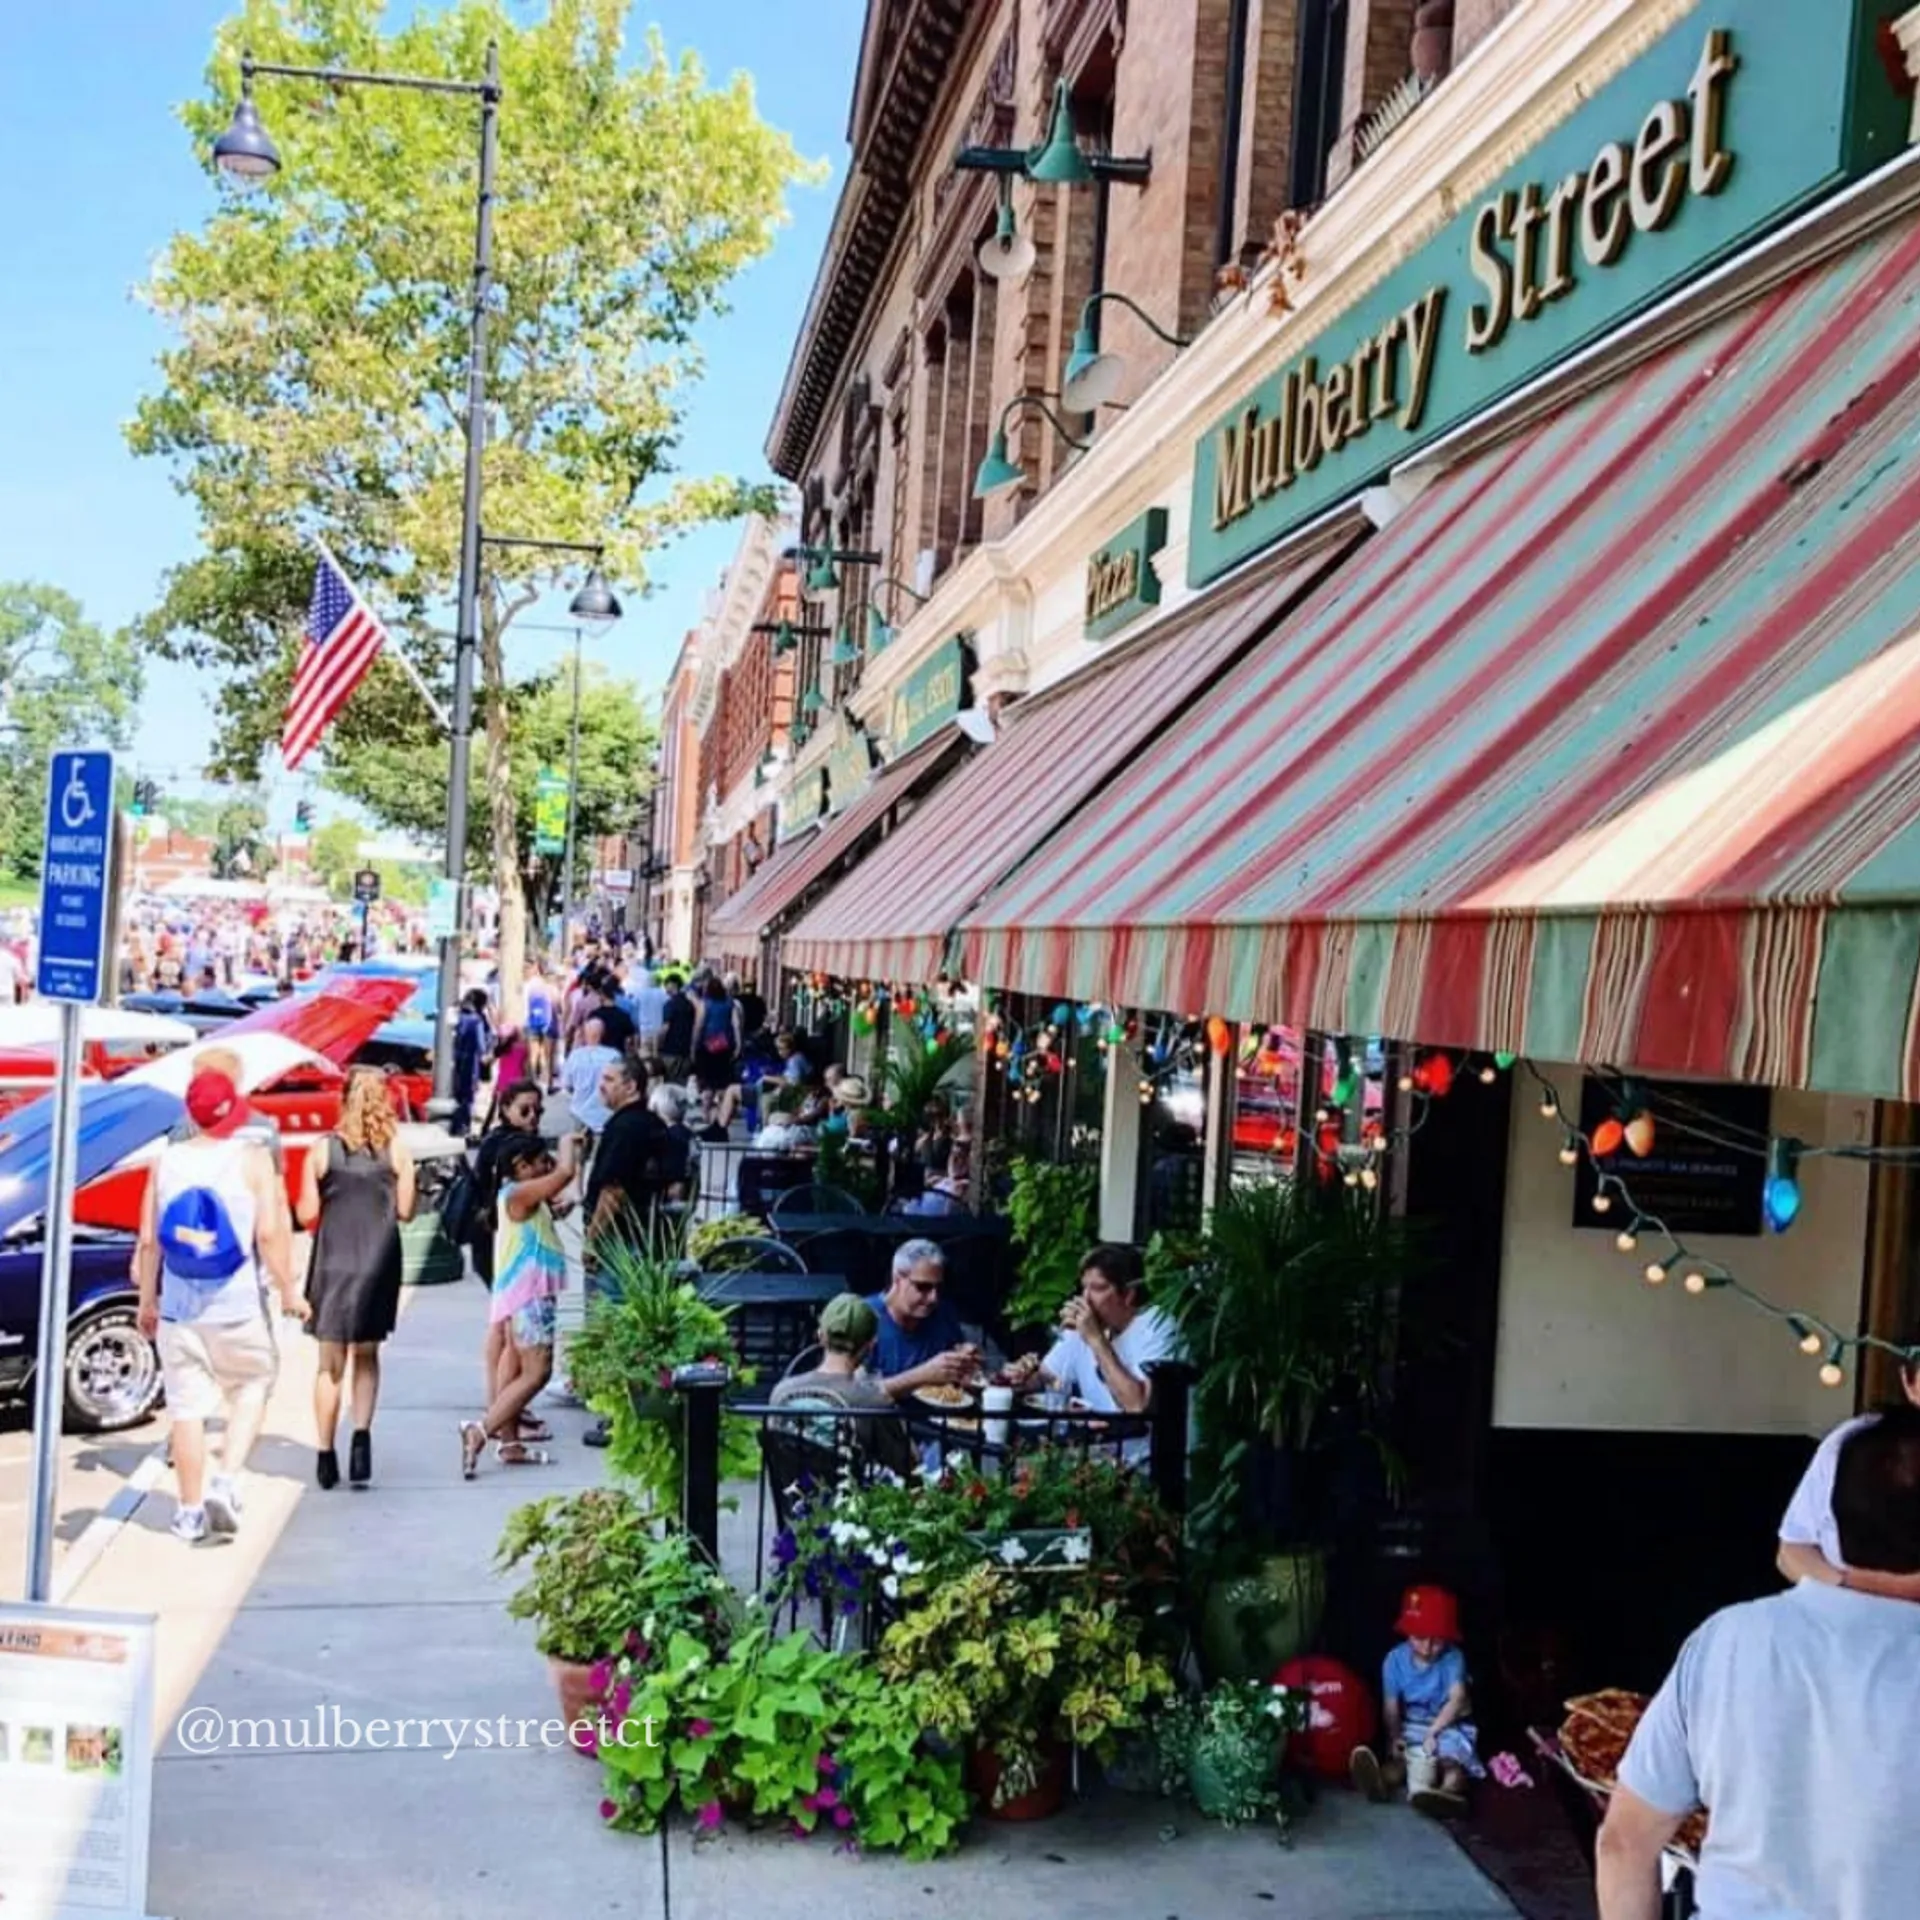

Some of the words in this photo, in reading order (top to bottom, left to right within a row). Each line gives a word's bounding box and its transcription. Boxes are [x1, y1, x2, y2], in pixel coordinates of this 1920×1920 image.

[1210, 285, 1448, 530] Mulberry
[1465, 28, 1740, 353] Street
[1086, 548, 1139, 626] Pizza
[49, 863, 101, 889] PARKING
